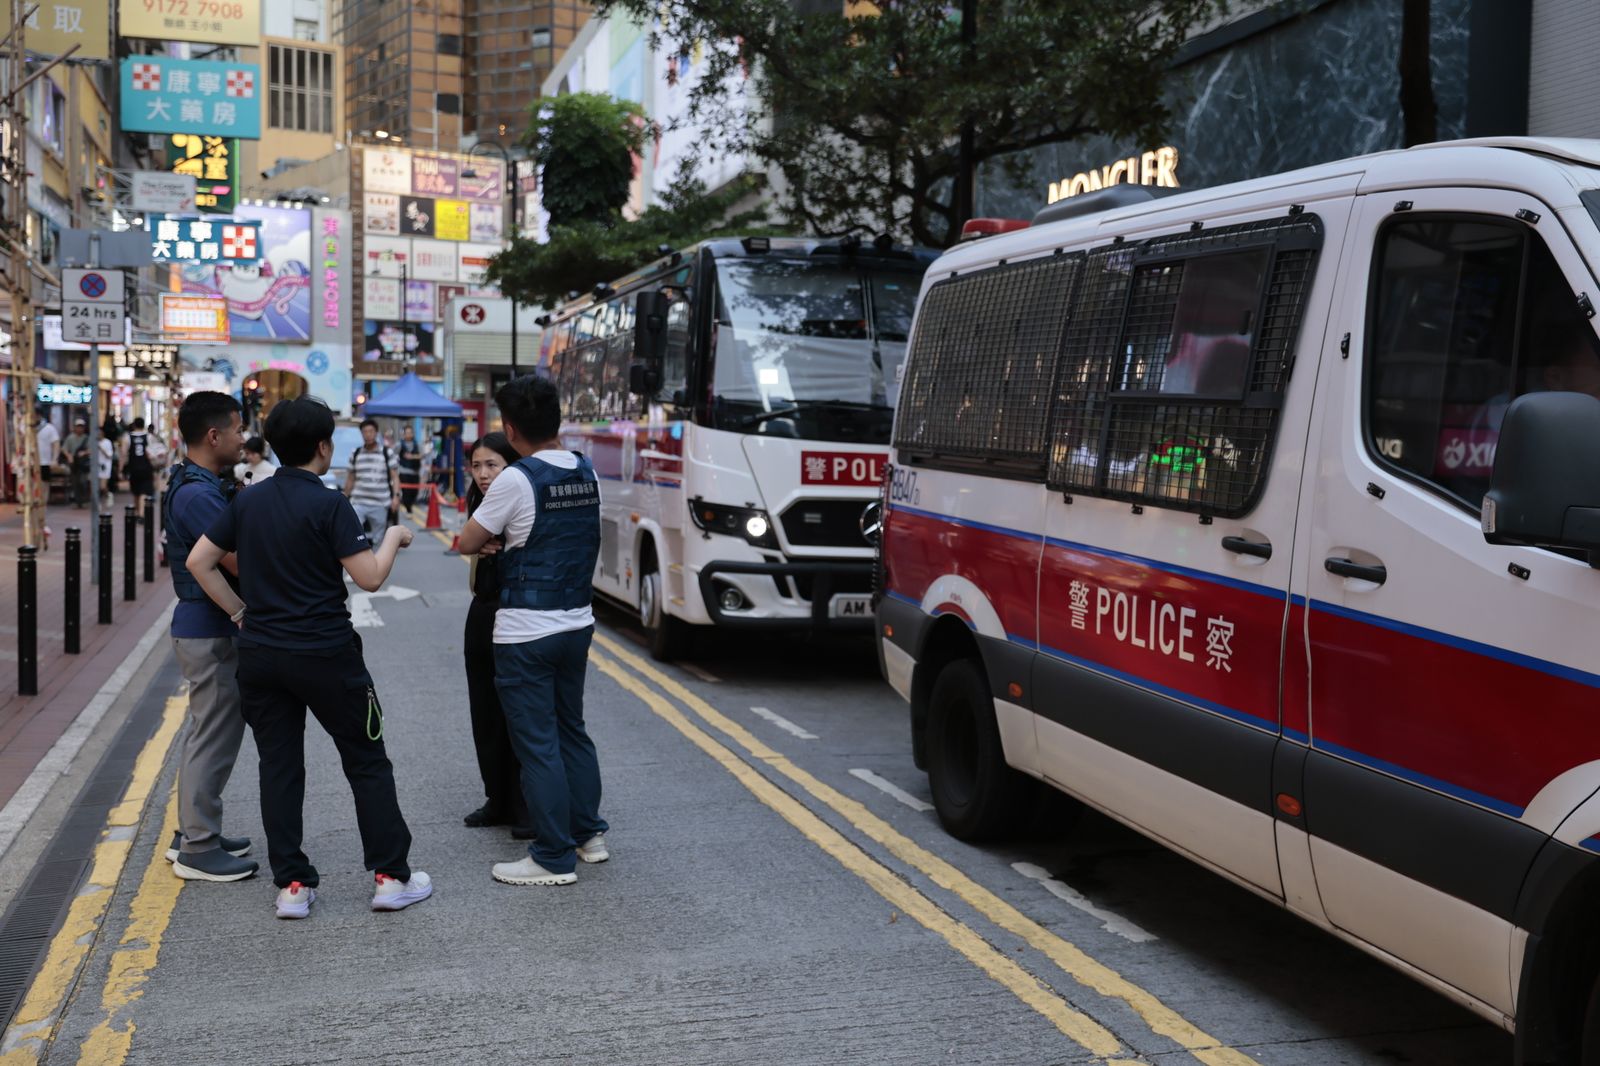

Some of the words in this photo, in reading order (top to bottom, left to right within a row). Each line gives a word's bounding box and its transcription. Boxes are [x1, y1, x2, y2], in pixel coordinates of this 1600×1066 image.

[144, 0, 188, 16] 9172
[198, 1, 243, 19] 7908
[146, 97, 236, 126] 大藥房
[1048, 146, 1180, 205] MONCLER
[70, 306, 90, 318] 24
[94, 308, 117, 320] hrs
[75, 321, 112, 338] 全日
[805, 457, 827, 481] 警
[833, 458, 883, 482] POL
[545, 501, 561, 510] FORCE
[843, 601, 866, 615] AM
[1068, 579, 1090, 631] 警
[1096, 586, 1197, 664] POLICE
[1206, 614, 1235, 674] 察
